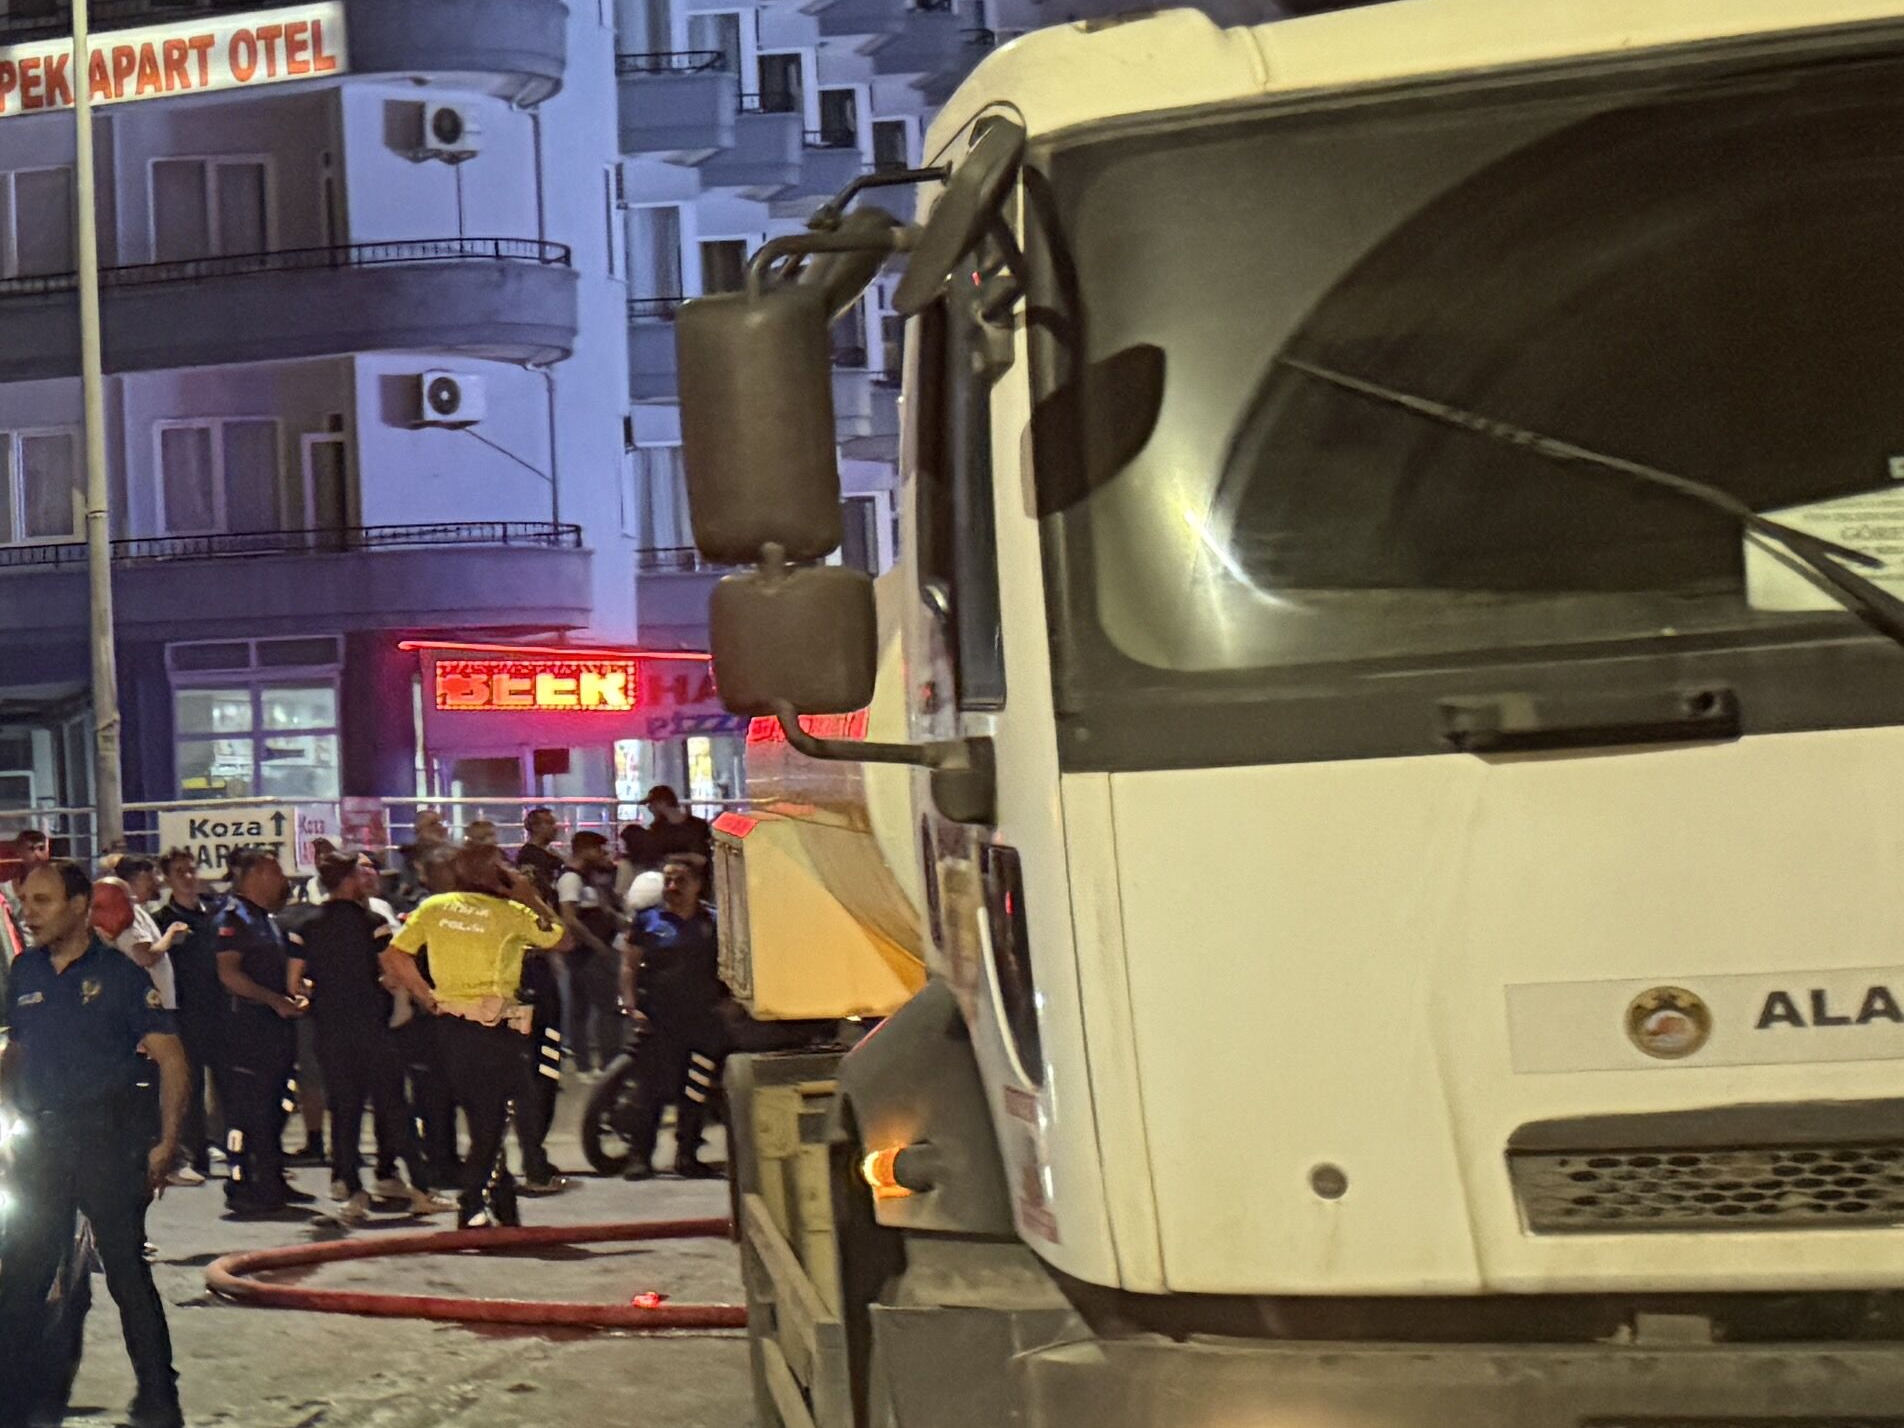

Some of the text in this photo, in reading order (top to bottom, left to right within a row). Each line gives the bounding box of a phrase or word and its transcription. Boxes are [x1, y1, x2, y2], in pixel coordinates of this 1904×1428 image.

[87, 33, 216, 101] APART
[228, 19, 337, 82] OTEL
[188, 818, 262, 840] Koza
